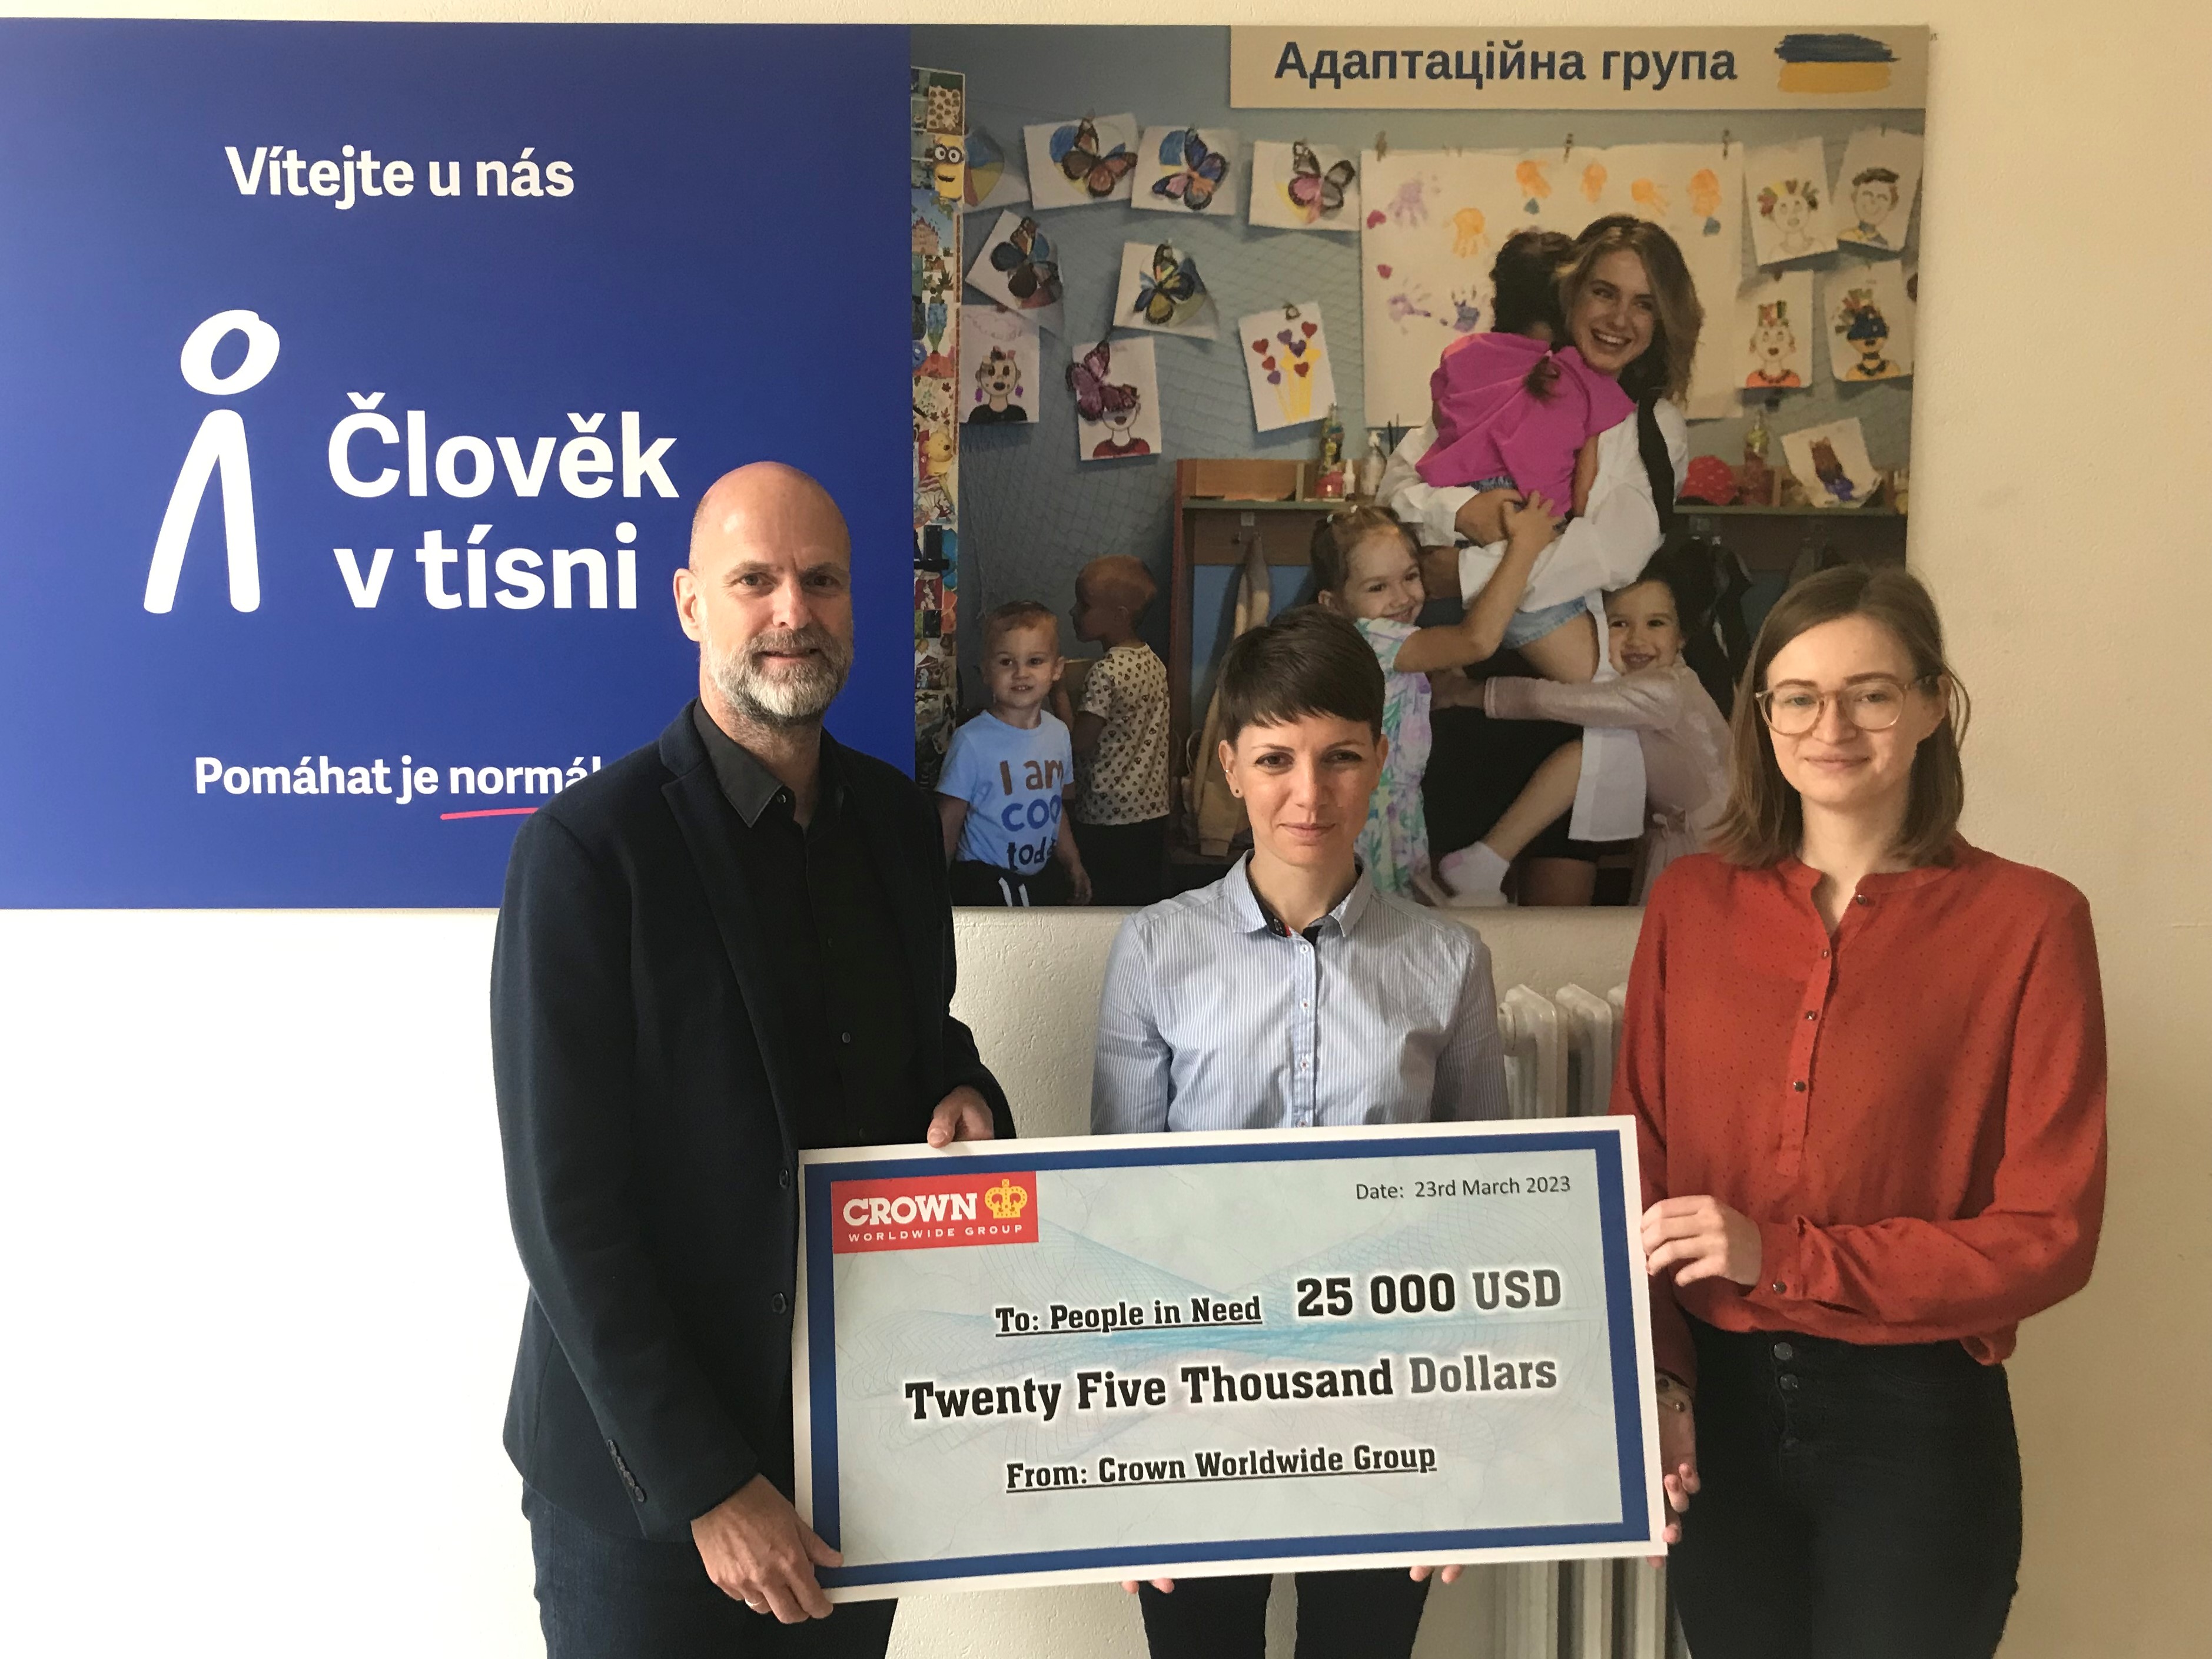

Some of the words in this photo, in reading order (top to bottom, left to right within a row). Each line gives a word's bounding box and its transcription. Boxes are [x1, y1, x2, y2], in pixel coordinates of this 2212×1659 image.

[1274, 39, 1587, 89] Адаптаційна
[1602, 50, 1738, 91] група
[224, 144, 414, 210] Vítejte
[429, 161, 461, 197] u
[476, 147, 574, 197] nás
[328, 391, 680, 498] Člověk
[333, 548, 394, 608] v
[416, 522, 637, 609] tísni
[195, 755, 392, 795] Pomáhat
[396, 755, 439, 804] je
[1000, 760, 1012, 795] I
[843, 1192, 978, 1226] CROWN
[1356, 1183, 1404, 1199] Date:
[1414, 1180, 1456, 1197] 23rd
[1462, 1177, 1520, 1196] March
[1526, 1175, 1570, 1194] 2023
[848, 1227, 955, 1242] WORLDWIDE
[965, 1224, 1022, 1236] GROUP
[995, 1307, 1039, 1332] To:
[1050, 1301, 1144, 1333] People
[1154, 1299, 1181, 1325] in
[1191, 1295, 1261, 1322] Need
[1297, 1277, 1353, 1317] 25
[1370, 1273, 1456, 1315] 000
[1472, 1269, 1561, 1310] USD
[905, 1378, 1061, 1421] Twenty
[1077, 1371, 1166, 1409] Five
[1181, 1358, 1393, 1403] Thousand
[1409, 1354, 1557, 1393] Dollars
[1007, 1462, 1088, 1488] From:
[1098, 1457, 1186, 1482] Crown
[1194, 1447, 1343, 1478] Worldwide
[1353, 1444, 1436, 1474] Group
